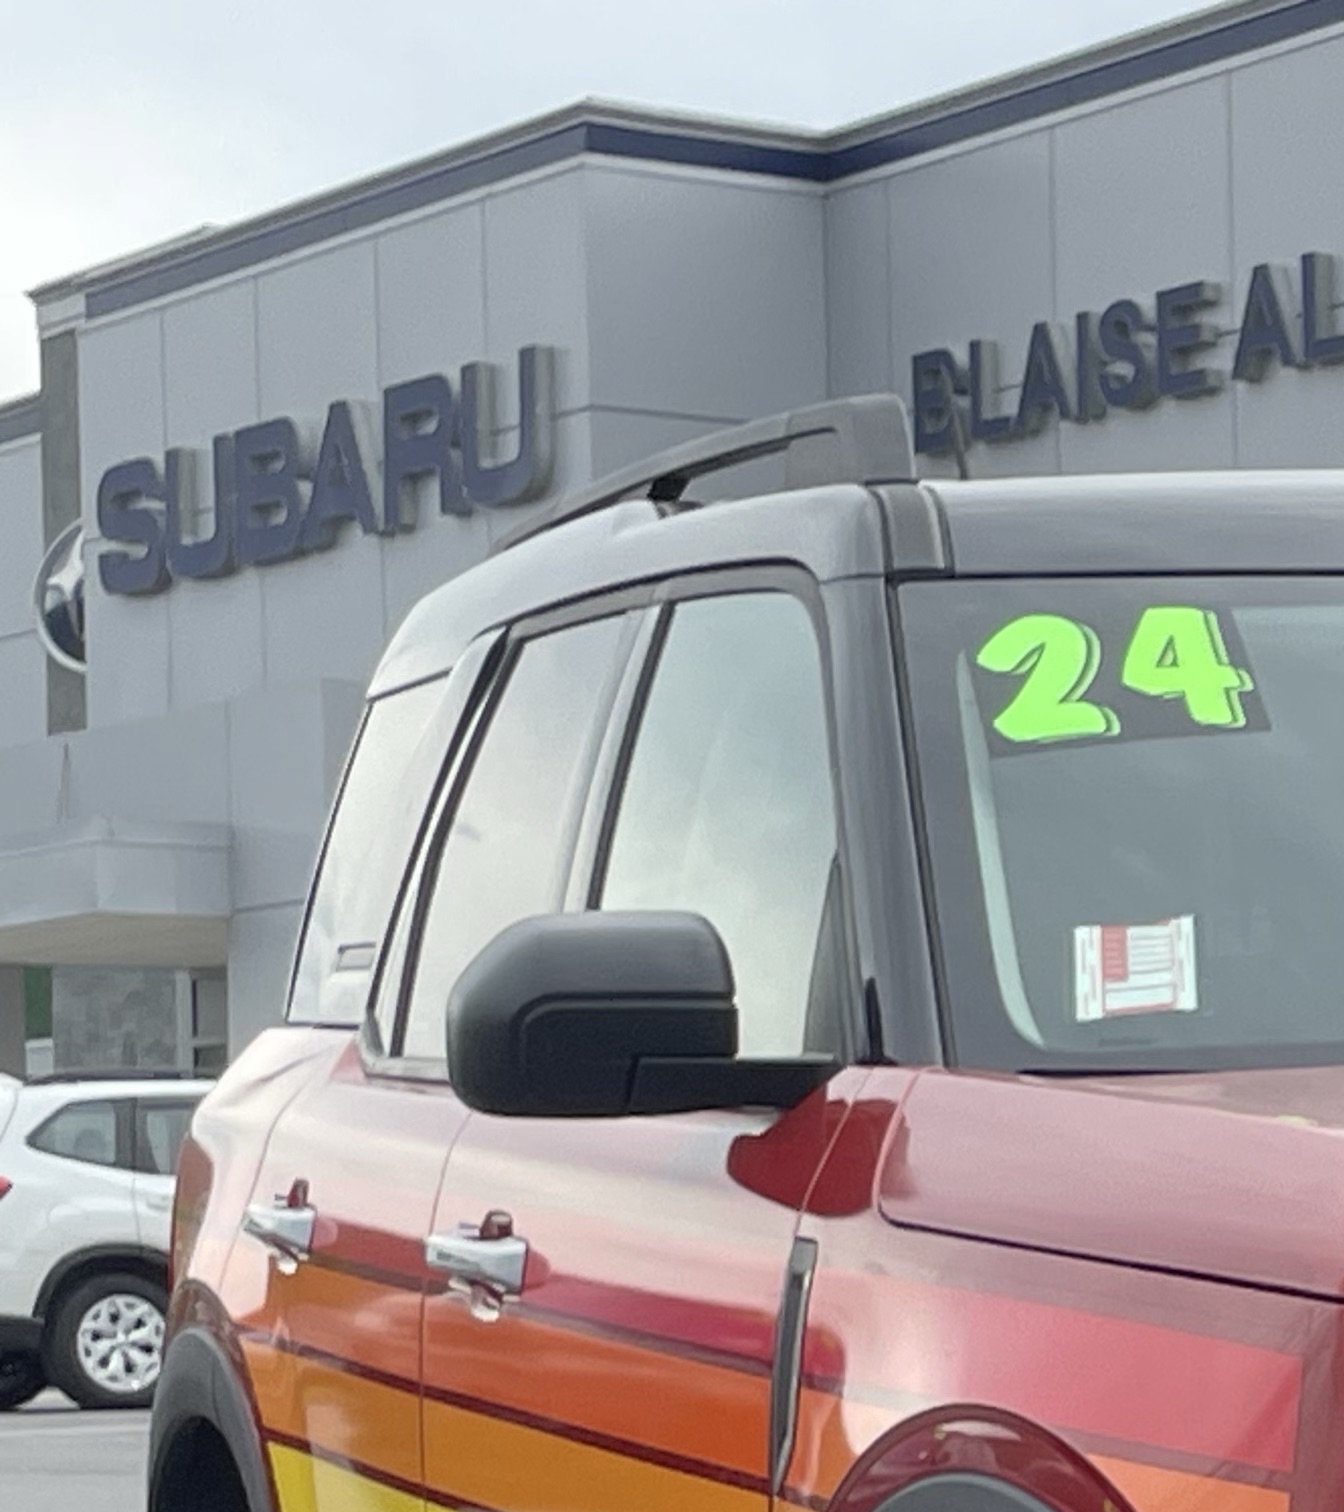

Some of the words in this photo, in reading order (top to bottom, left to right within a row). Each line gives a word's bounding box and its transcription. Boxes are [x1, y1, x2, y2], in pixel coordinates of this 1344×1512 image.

[912, 279, 1221, 455] BLAISE
[97, 344, 553, 595] SUBARU
[976, 606, 1253, 742] 24
